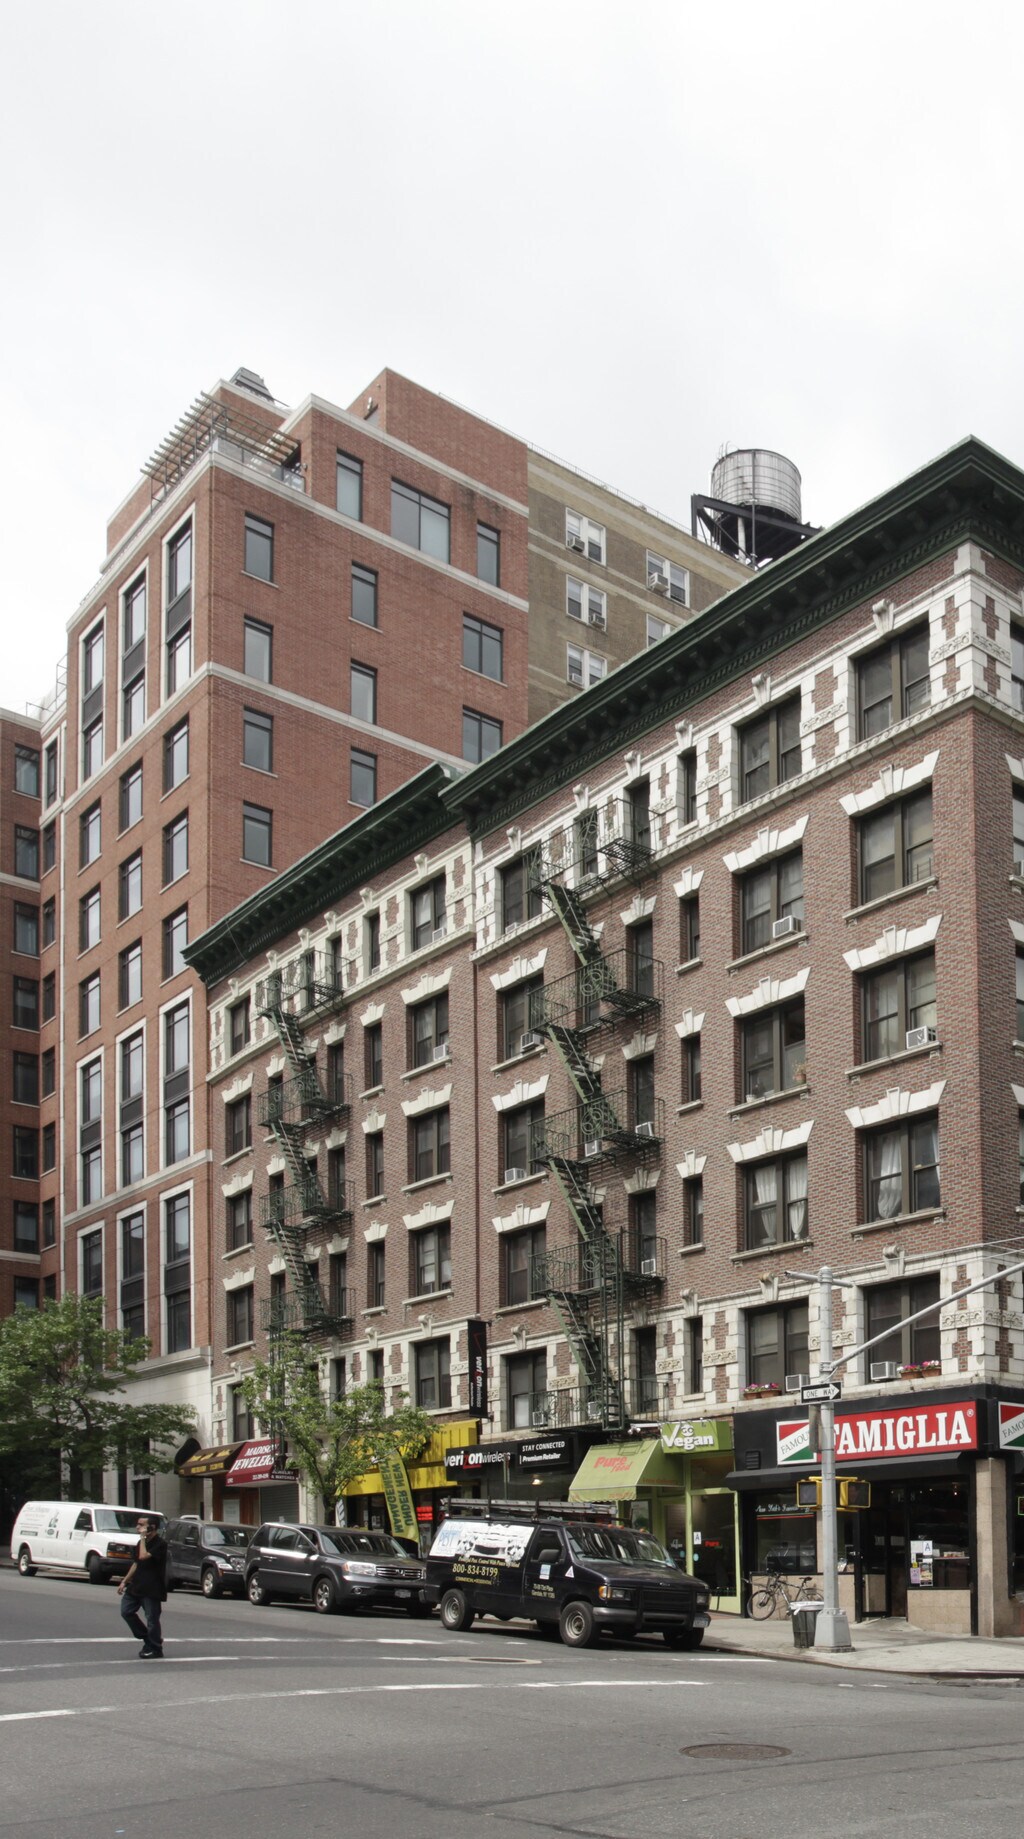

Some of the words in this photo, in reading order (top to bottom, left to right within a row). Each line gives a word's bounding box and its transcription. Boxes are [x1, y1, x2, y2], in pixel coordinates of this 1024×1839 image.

[823, 1387, 835, 1396] WAY
[662, 1424, 714, 1450] Vegan
[780, 1431, 809, 1455] FAMOU
[522, 1444, 535, 1452] STAY
[535, 1441, 566, 1450] CONNECTED
[229, 1454, 275, 1473] JEWELERS
[522, 1454, 543, 1462] Premium
[542, 1452, 562, 1460] Retailer
[594, 1456, 627, 1469] Pure
[925, 1543, 931, 1552] A
[452, 1563, 498, 1577] 800-834-8199
